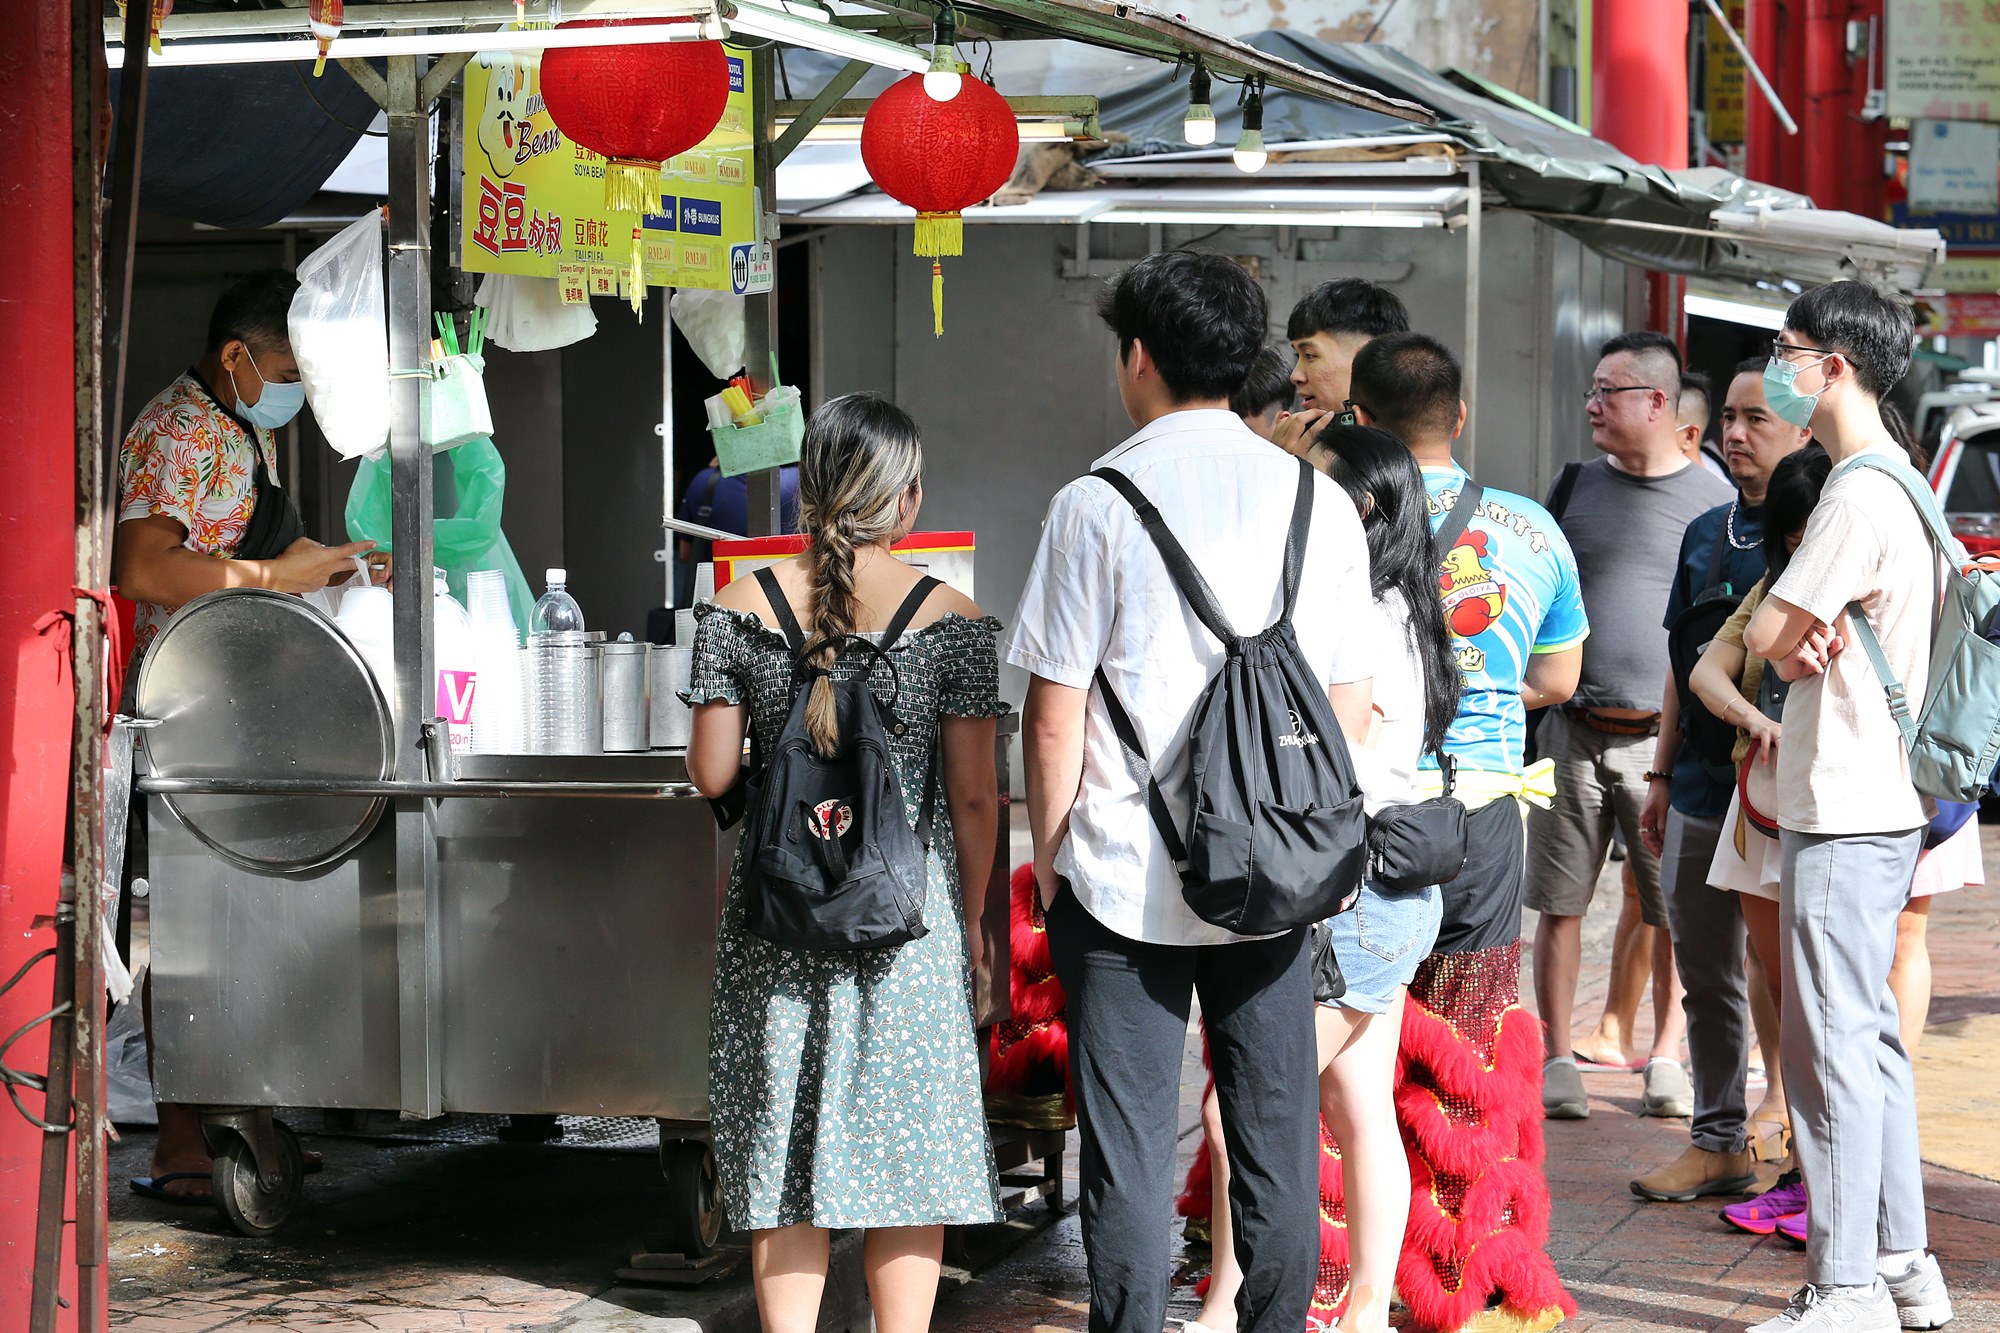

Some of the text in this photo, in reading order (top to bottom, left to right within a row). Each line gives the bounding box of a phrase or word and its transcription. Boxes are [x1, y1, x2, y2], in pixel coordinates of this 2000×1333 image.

[730, 76, 742, 87] ESAR
[515, 120, 561, 165] Bean
[574, 164, 590, 177] SOYA
[575, 218, 608, 247] 豆腐花
[591, 267, 603, 275] Brown
